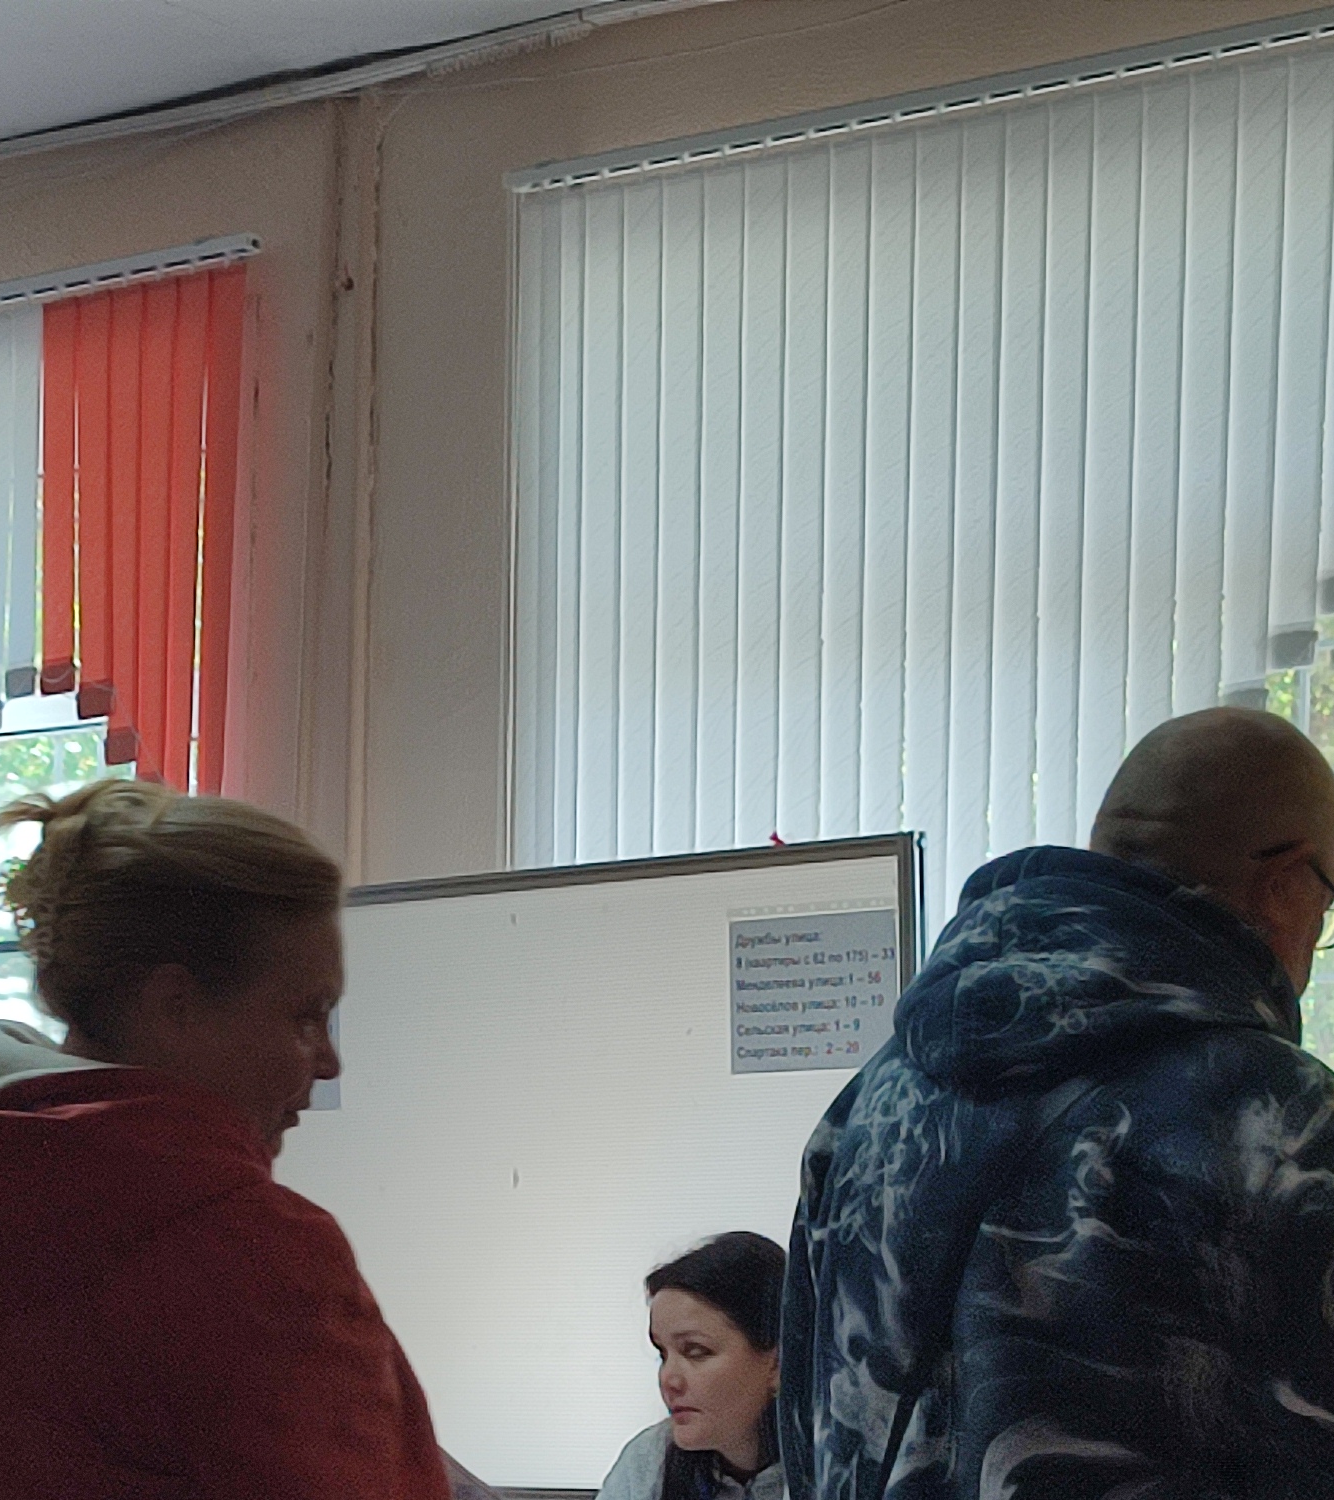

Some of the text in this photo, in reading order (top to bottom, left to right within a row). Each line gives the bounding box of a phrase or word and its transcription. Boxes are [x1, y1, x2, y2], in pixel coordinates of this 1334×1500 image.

[828, 954, 843, 962] по
[737, 1024, 789, 1036] Сельская
[834, 1020, 840, 1031] 1
[737, 1046, 787, 1060] Спартака
[826, 1043, 833, 1054] 2
